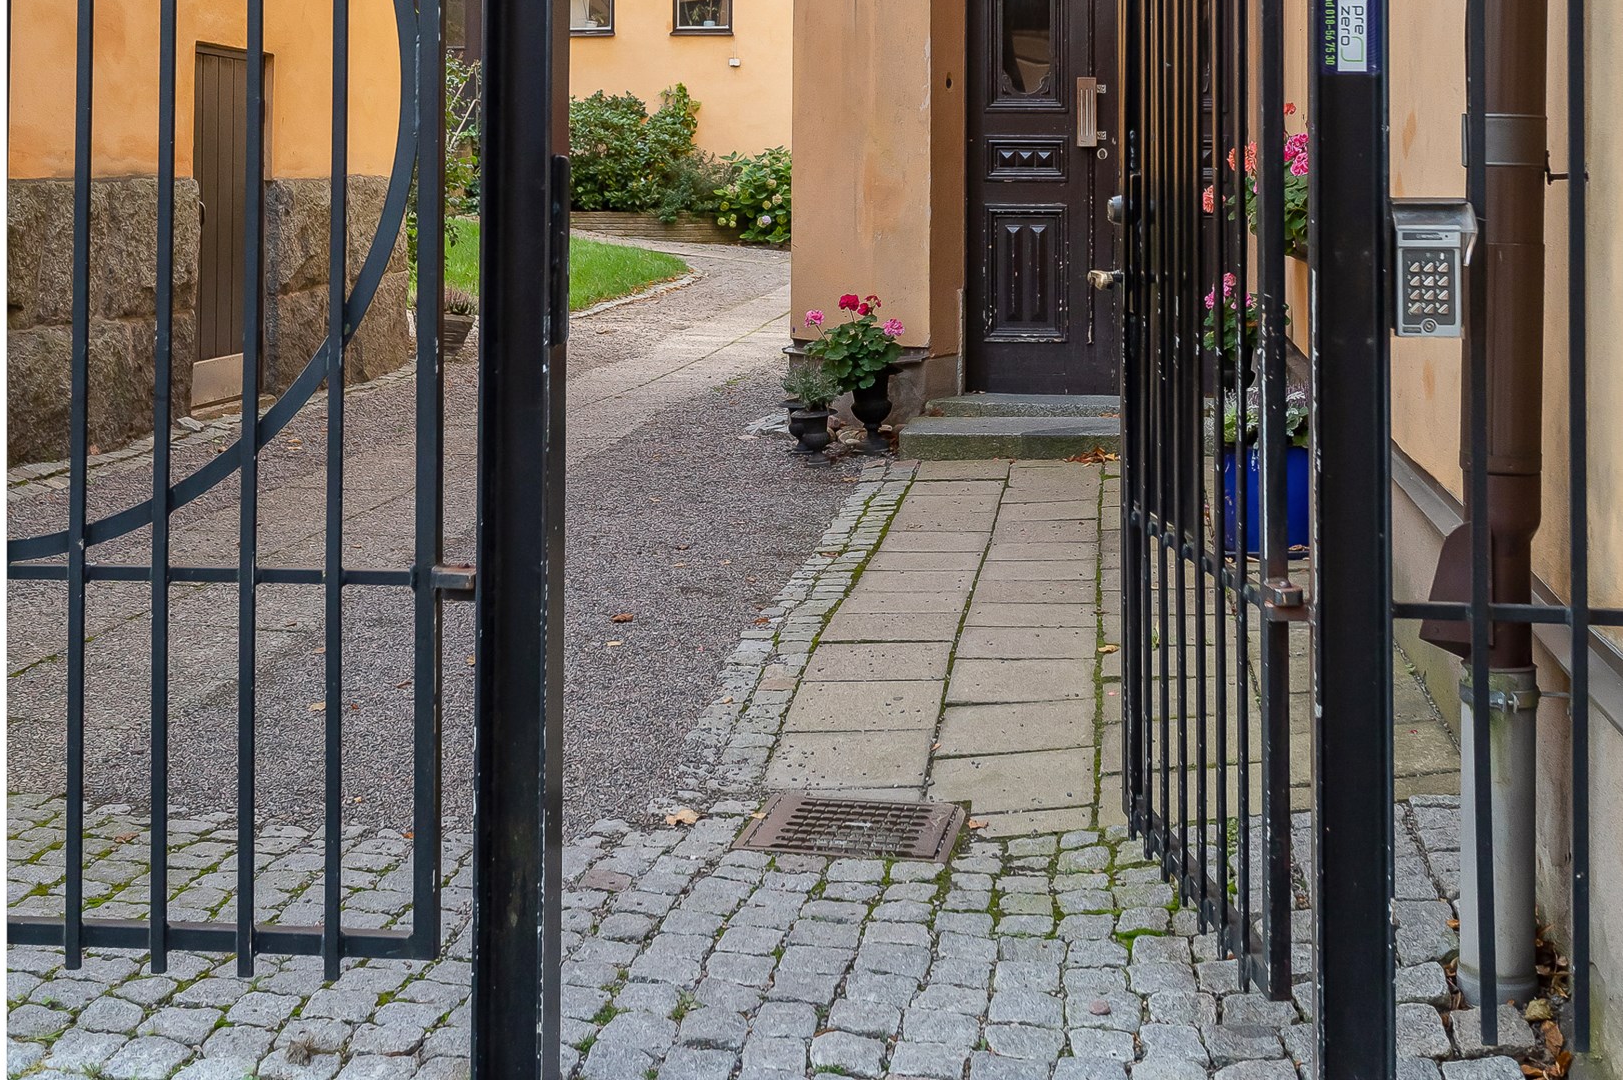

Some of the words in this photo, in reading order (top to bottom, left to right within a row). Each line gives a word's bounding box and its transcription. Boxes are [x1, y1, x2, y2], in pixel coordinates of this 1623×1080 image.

[1340, 6, 1351, 46] zero
[1352, 5, 1364, 35] pre
[1324, 42, 1335, 53] 75
[1324, 54, 1335, 65] 30
